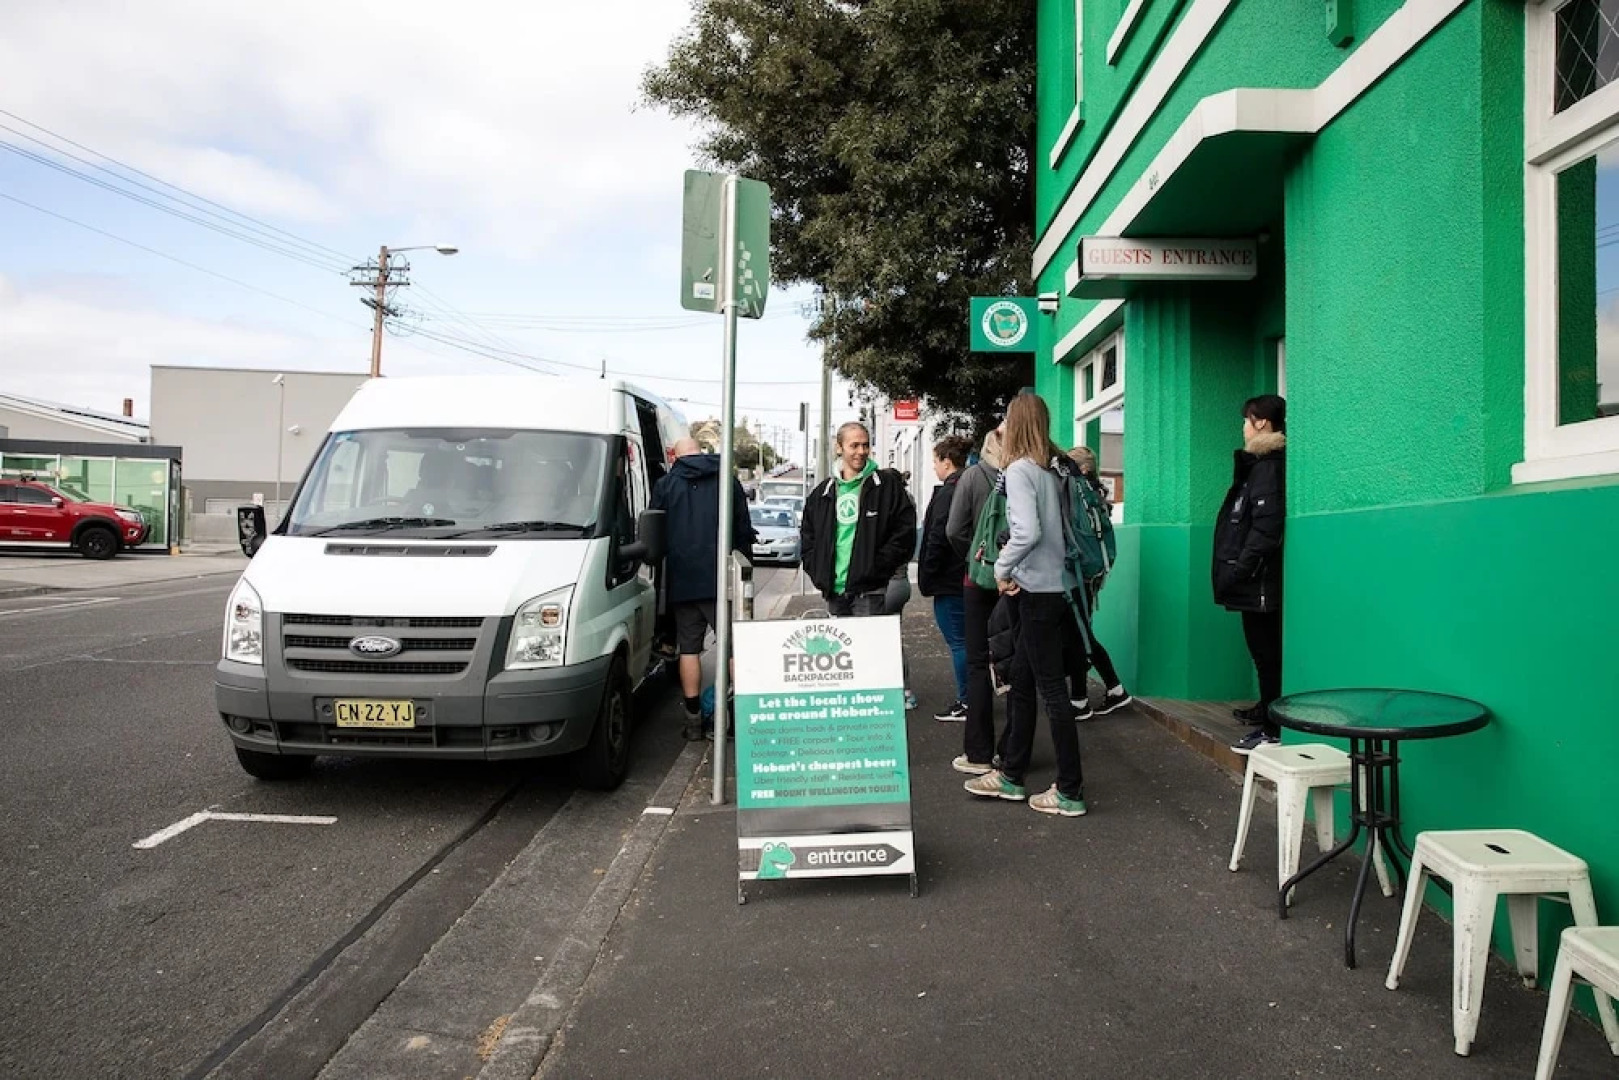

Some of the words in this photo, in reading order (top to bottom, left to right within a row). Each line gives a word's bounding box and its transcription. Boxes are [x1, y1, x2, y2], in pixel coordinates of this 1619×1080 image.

[1089, 249, 1151, 265] GUESTS
[1163, 249, 1252, 265] ENTRANCE
[782, 629, 805, 650] THE
[805, 624, 853, 647] PICKLED
[783, 651, 853, 672] FROG
[784, 672, 854, 682] BACKPACKERS
[758, 697, 781, 709] Let
[784, 696, 806, 707] the
[810, 694, 848, 707] locals
[851, 693, 885, 705] show
[750, 712, 775, 724] you
[778, 708, 827, 720] around
[831, 706, 895, 718] Hobart...
[778, 735, 800, 745] FREE
[753, 762, 806, 774] Hobart's
[808, 759, 862, 772] cheapest
[751, 789, 774, 799] FREE
[775, 788, 807, 798] MOUNT
[807, 848, 887, 864] entrance
